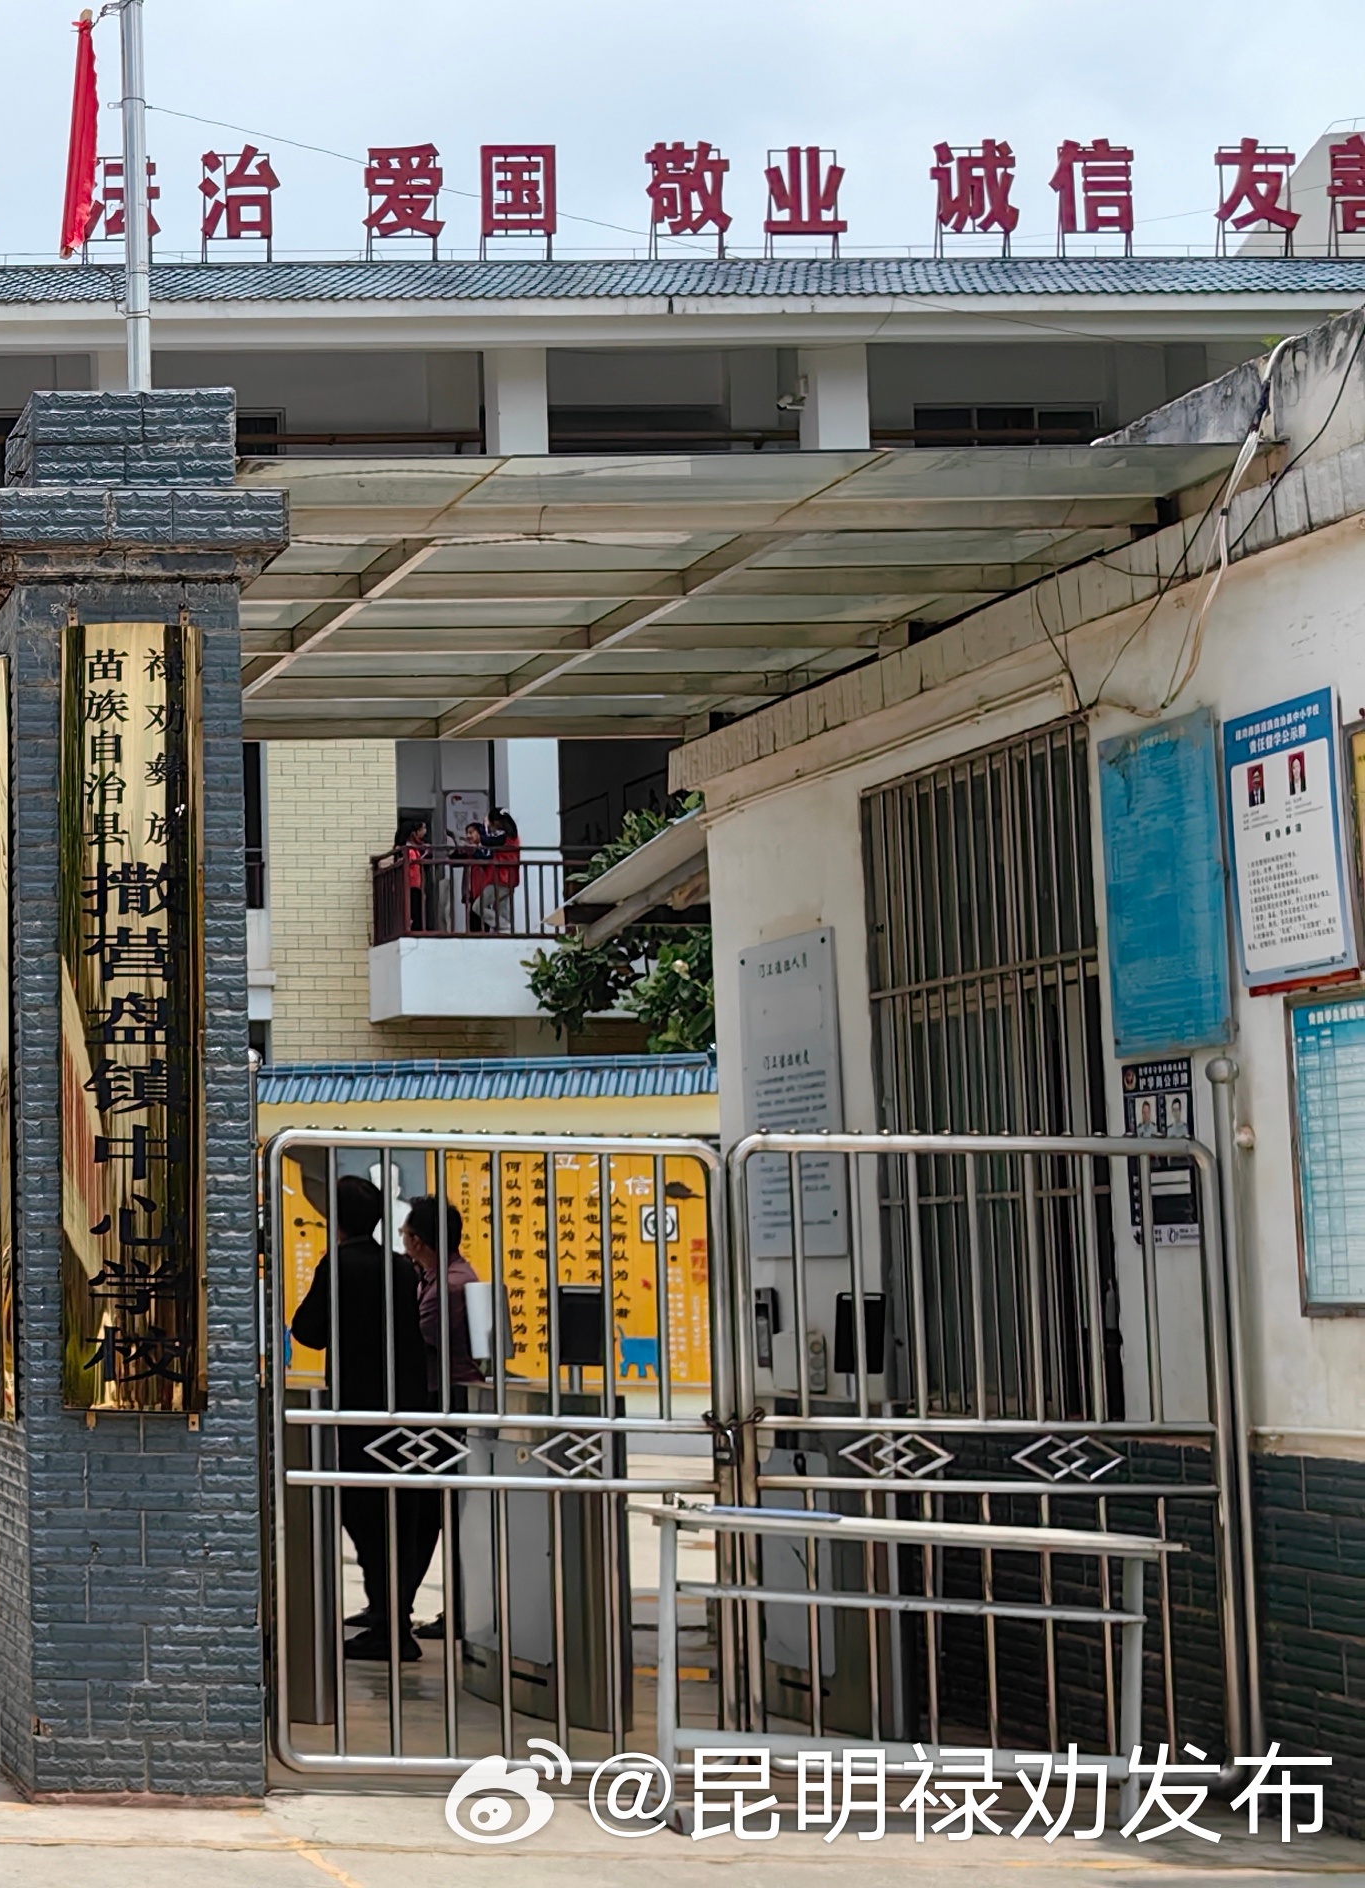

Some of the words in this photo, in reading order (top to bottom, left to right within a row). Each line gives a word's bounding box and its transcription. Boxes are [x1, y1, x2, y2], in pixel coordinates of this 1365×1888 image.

[363, 143, 557, 237] 爱国
[645, 140, 849, 236] 敬业
[930, 138, 1133, 233] 诚信
[83, 648, 130, 848] 苗族自治县
[142, 647, 187, 848] 禄劝彝族
[82, 861, 191, 1384] 撒营盘镇中心学校
